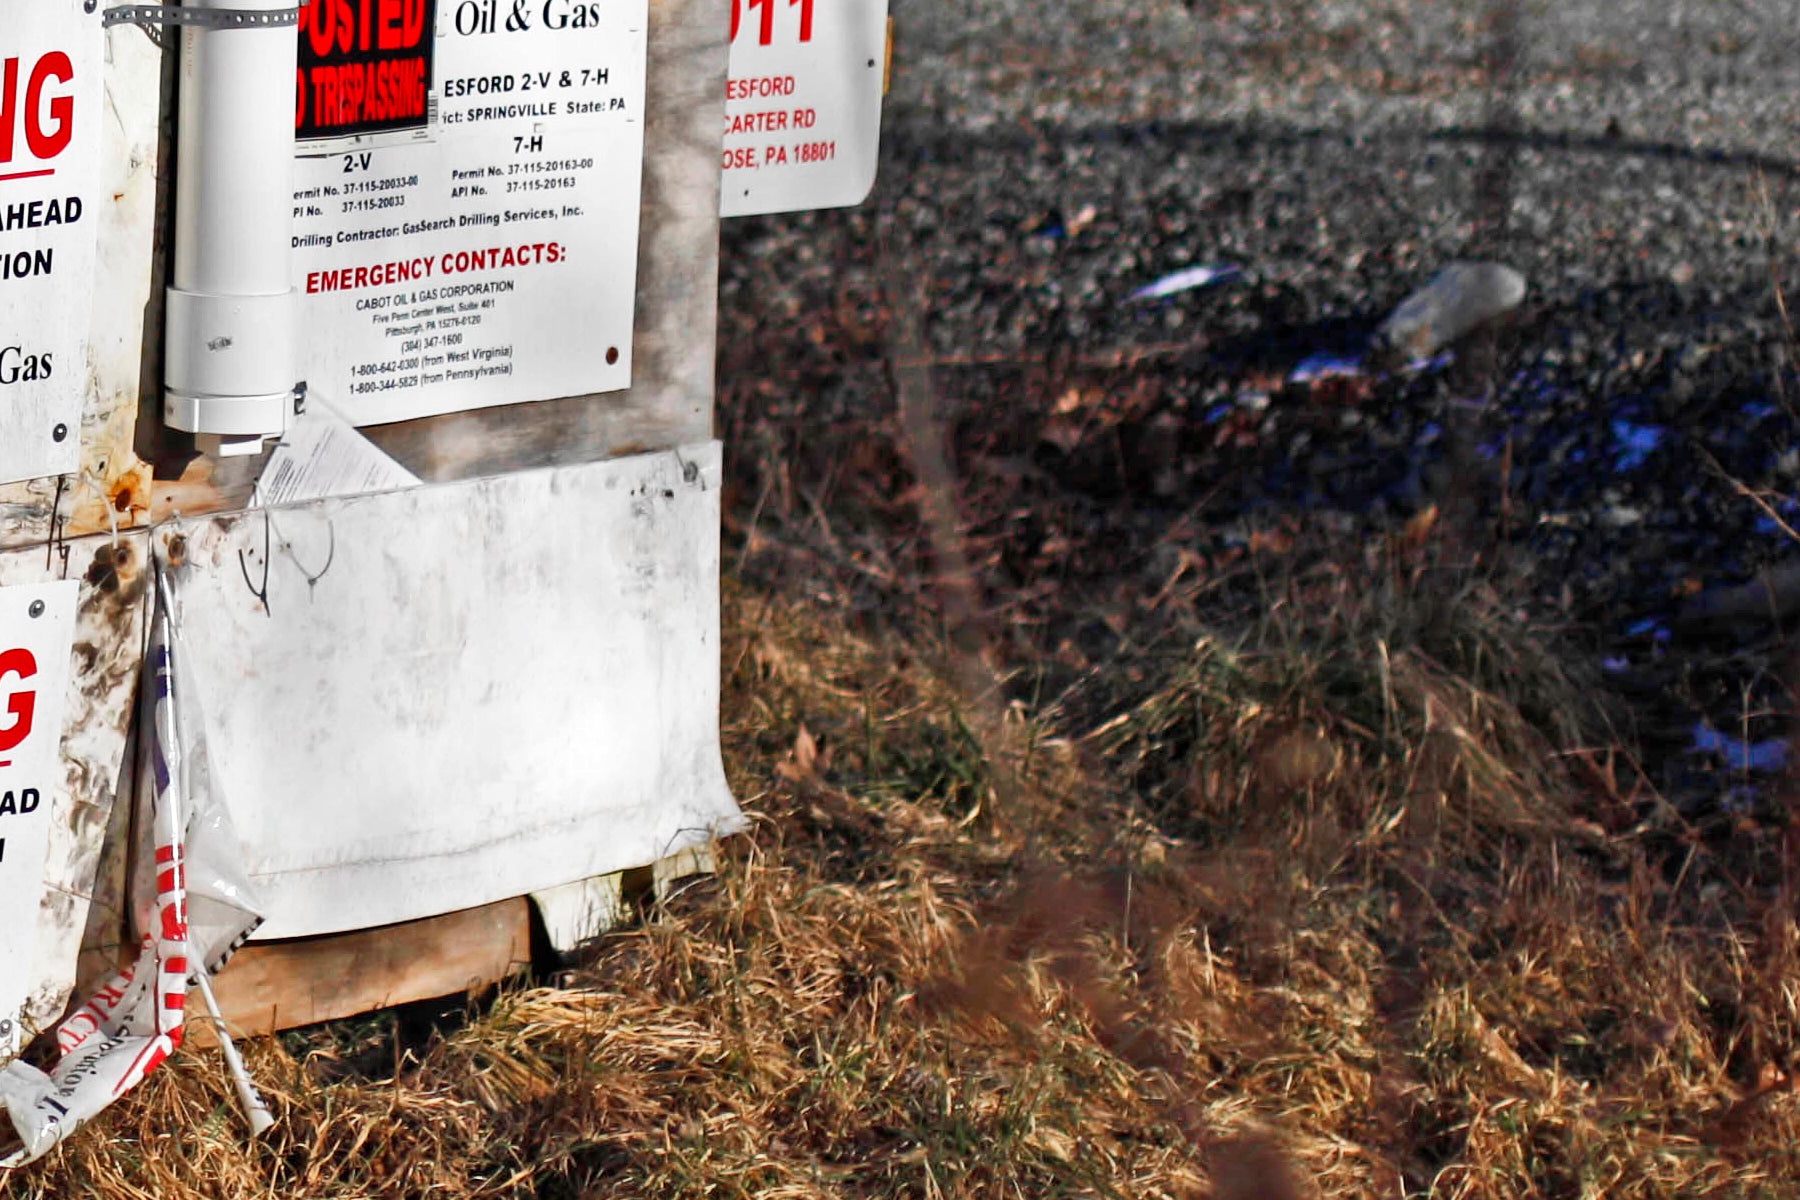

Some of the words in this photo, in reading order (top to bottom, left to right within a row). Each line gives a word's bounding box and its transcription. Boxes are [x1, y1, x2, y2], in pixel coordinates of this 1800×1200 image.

[455, 0, 496, 36] Oil
[311, 57, 426, 127] TRESPASSING
[444, 74, 515, 98] ESFORD
[521, 71, 550, 92] 2-V
[559, 70, 572, 87] &
[581, 68, 609, 87] 7-H
[726, 76, 795, 100] ESFORD
[443, 109, 464, 125] ict:
[467, 101, 557, 123] SPRINGVILLE
[567, 100, 607, 115] State:
[610, 98, 626, 112] PA
[793, 108, 816, 128] RD
[513, 135, 543, 154] 7-H
[721, 147, 760, 170] OSE,
[765, 146, 788, 164] PA
[793, 141, 835, 162] 18801
[343, 151, 372, 173] 2-V
[452, 166, 486, 180] Permit
[488, 164, 504, 177] No.
[508, 158, 593, 175] 37-115-20163-00
[293, 186, 321, 200] ermit
[324, 185, 340, 197] No.
[452, 186, 469, 198] API
[471, 185, 488, 197] No.
[506, 177, 576, 193] 37-115-20163
[293, 207, 303, 218] PI
[306, 205, 323, 217] No.
[342, 195, 405, 213] 37-115-20033
[292, 233, 333, 248] Drilling
[337, 227, 400, 242] Contractor:
[403, 217, 456, 234] GasSearch
[460, 212, 500, 228] Drilling
[504, 208, 558, 222] Services,
[562, 205, 584, 217] Inc.
[306, 256, 435, 294] EMERGENCY
[441, 242, 567, 275] CONTACTS:
[356, 296, 391, 311] CABOT
[394, 294, 408, 305] OIL
[419, 289, 438, 301] GAS
[440, 280, 514, 298] CORPORATION
[447, 351, 470, 363] West
[473, 345, 513, 362] Virginia)
[446, 362, 513, 381] Pennsylvania)
